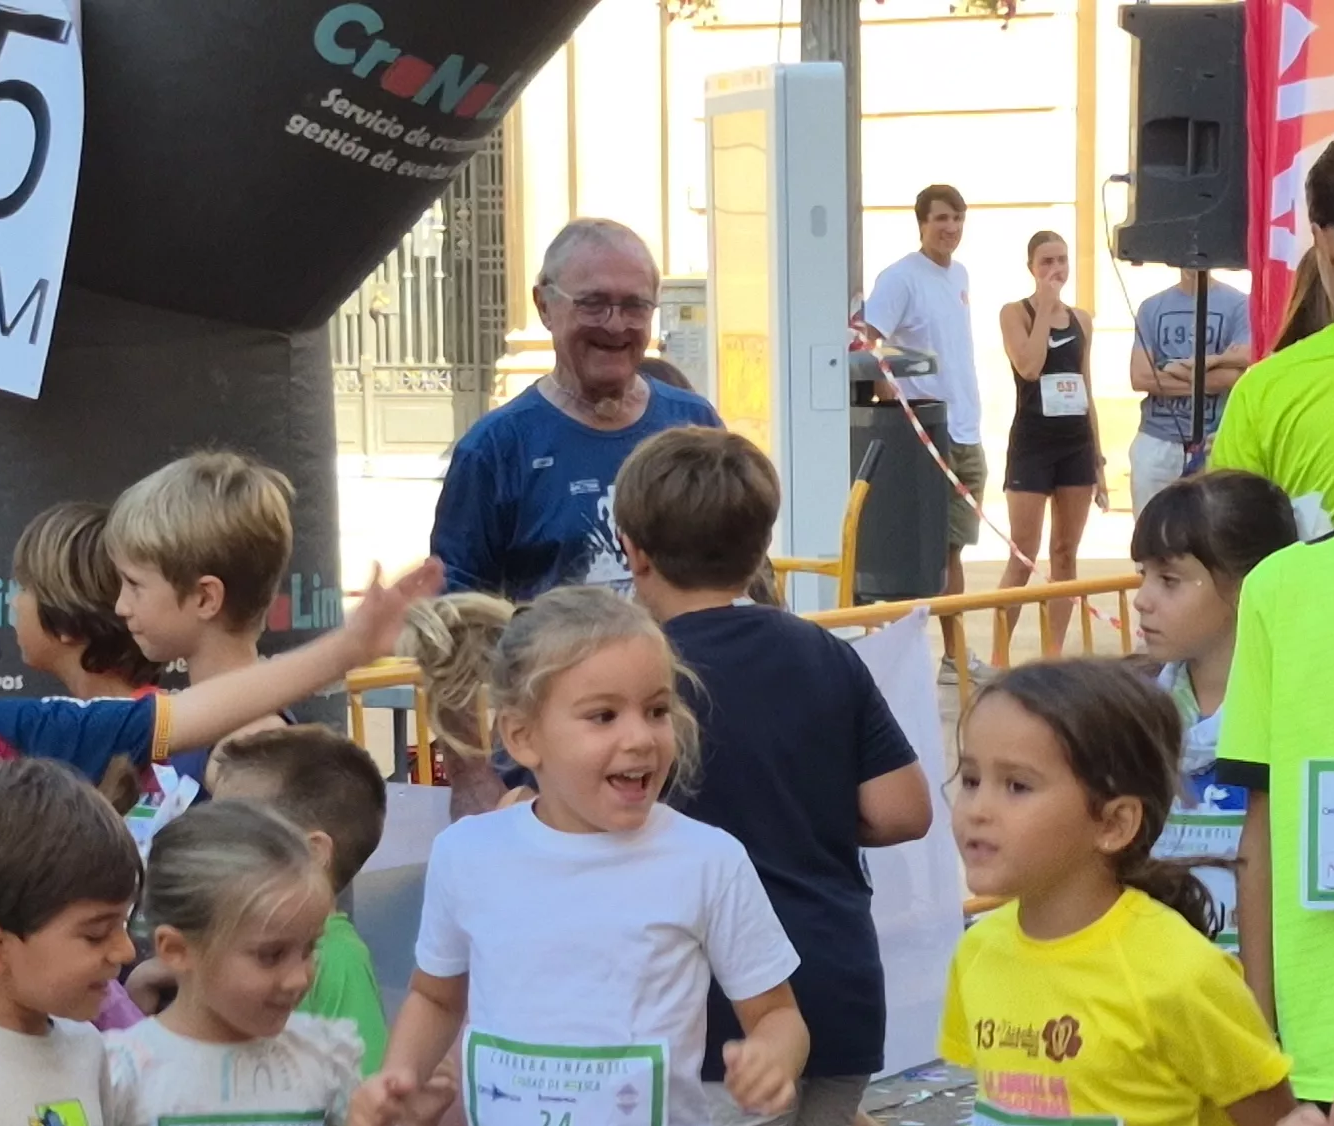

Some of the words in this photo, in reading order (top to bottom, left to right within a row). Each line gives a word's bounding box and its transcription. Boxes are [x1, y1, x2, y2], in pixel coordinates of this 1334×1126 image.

[285, 113, 371, 163] gestión
[369, 149, 398, 172] de
[320, 87, 405, 139] Servicio
[403, 125, 431, 149] de
[974, 1018, 995, 1050] 13
